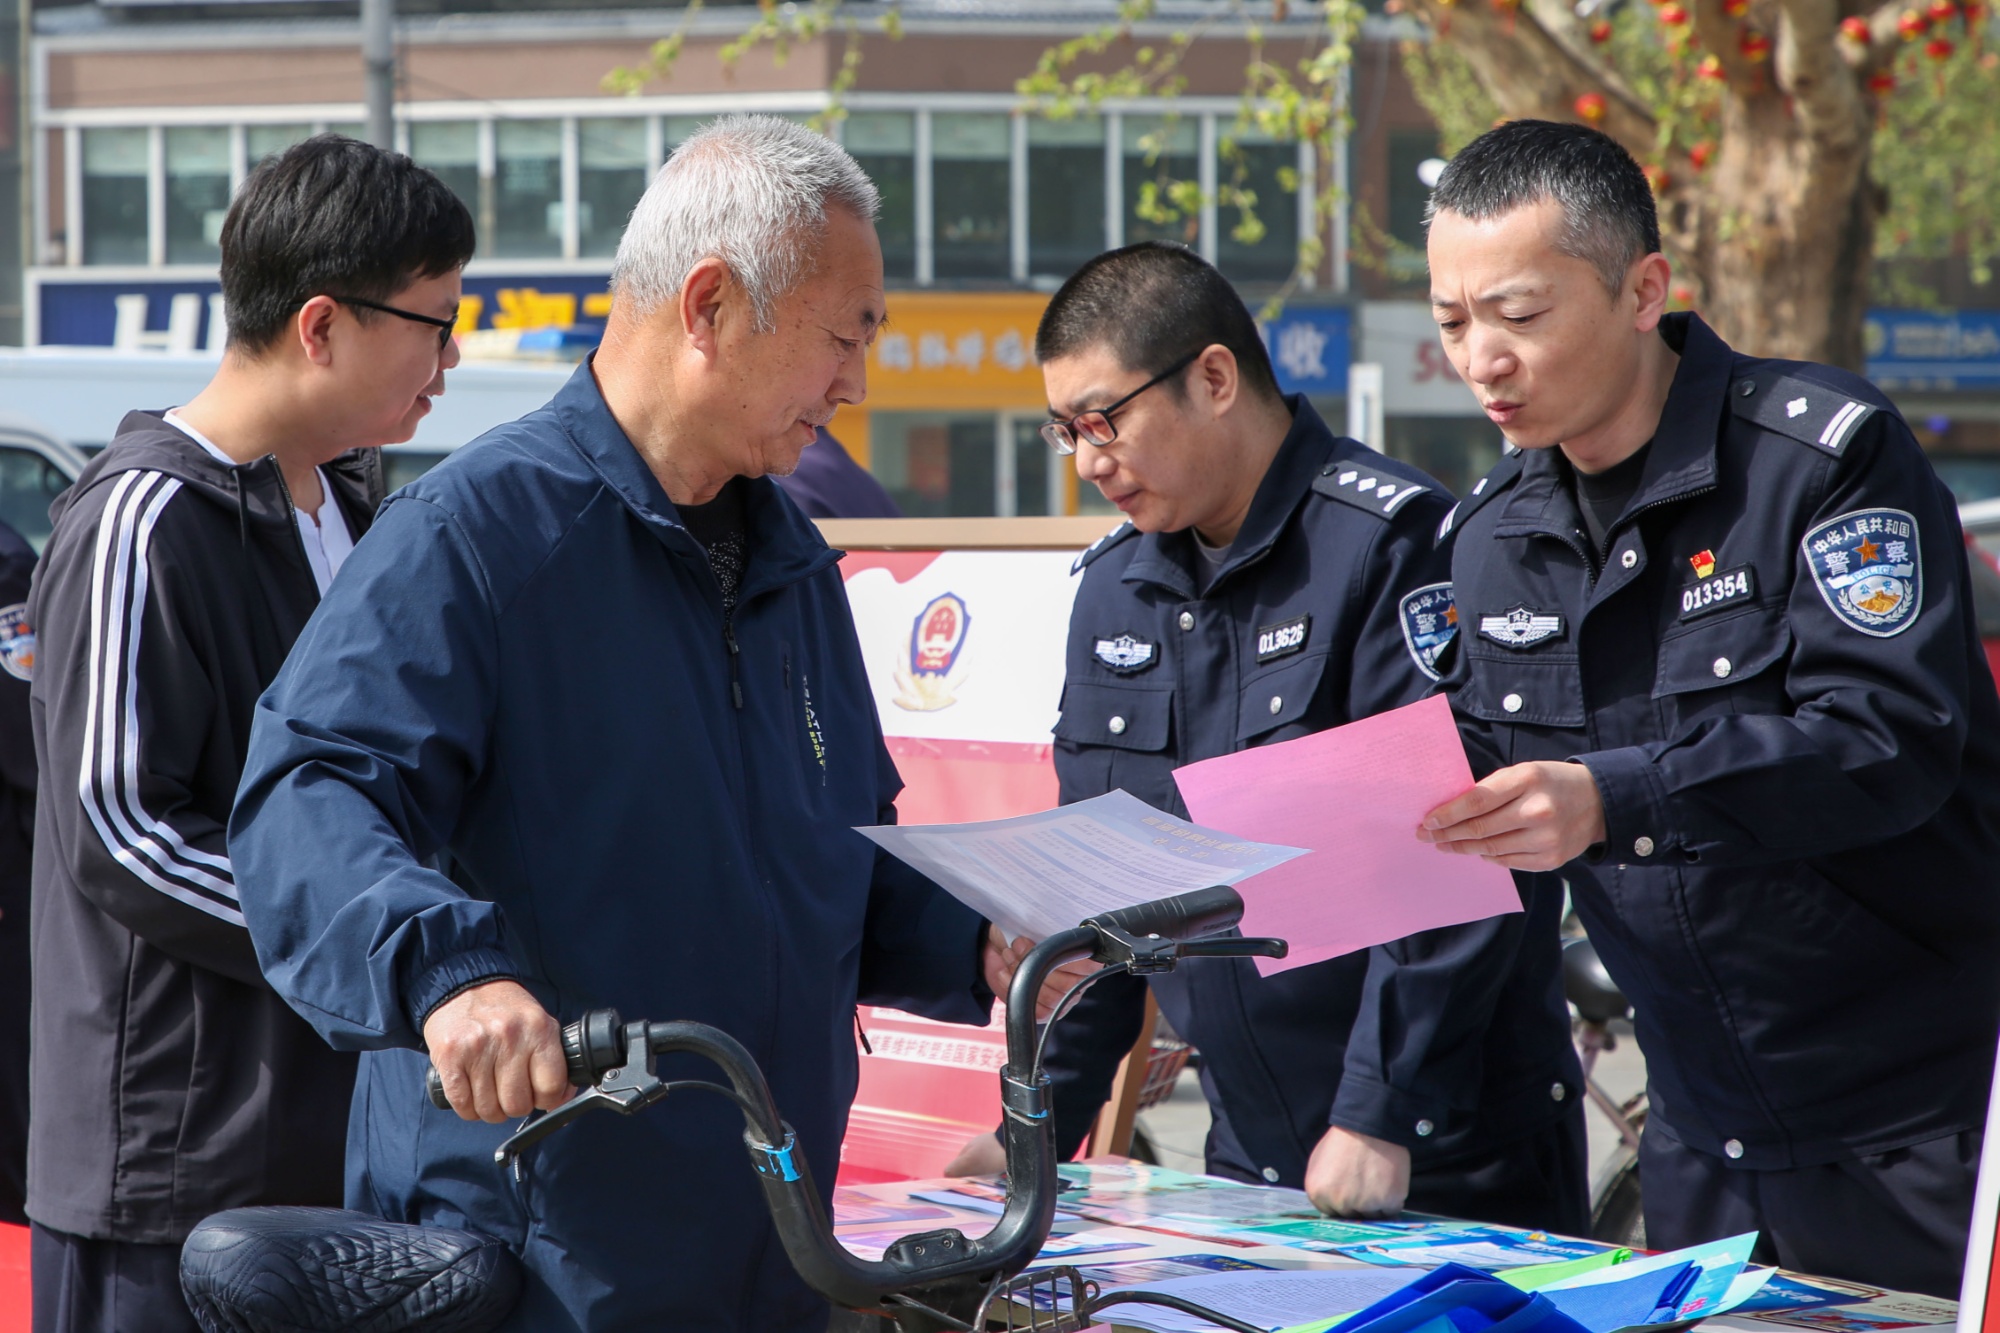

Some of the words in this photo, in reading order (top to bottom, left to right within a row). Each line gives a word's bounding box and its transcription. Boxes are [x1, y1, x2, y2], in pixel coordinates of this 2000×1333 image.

[1260, 320, 1328, 380] 收
[1813, 517, 1910, 554] 中华人民共和国
[1682, 571, 1748, 612] 013354
[1852, 565, 1895, 581] POLICE
[1860, 580, 1893, 595] 公安
